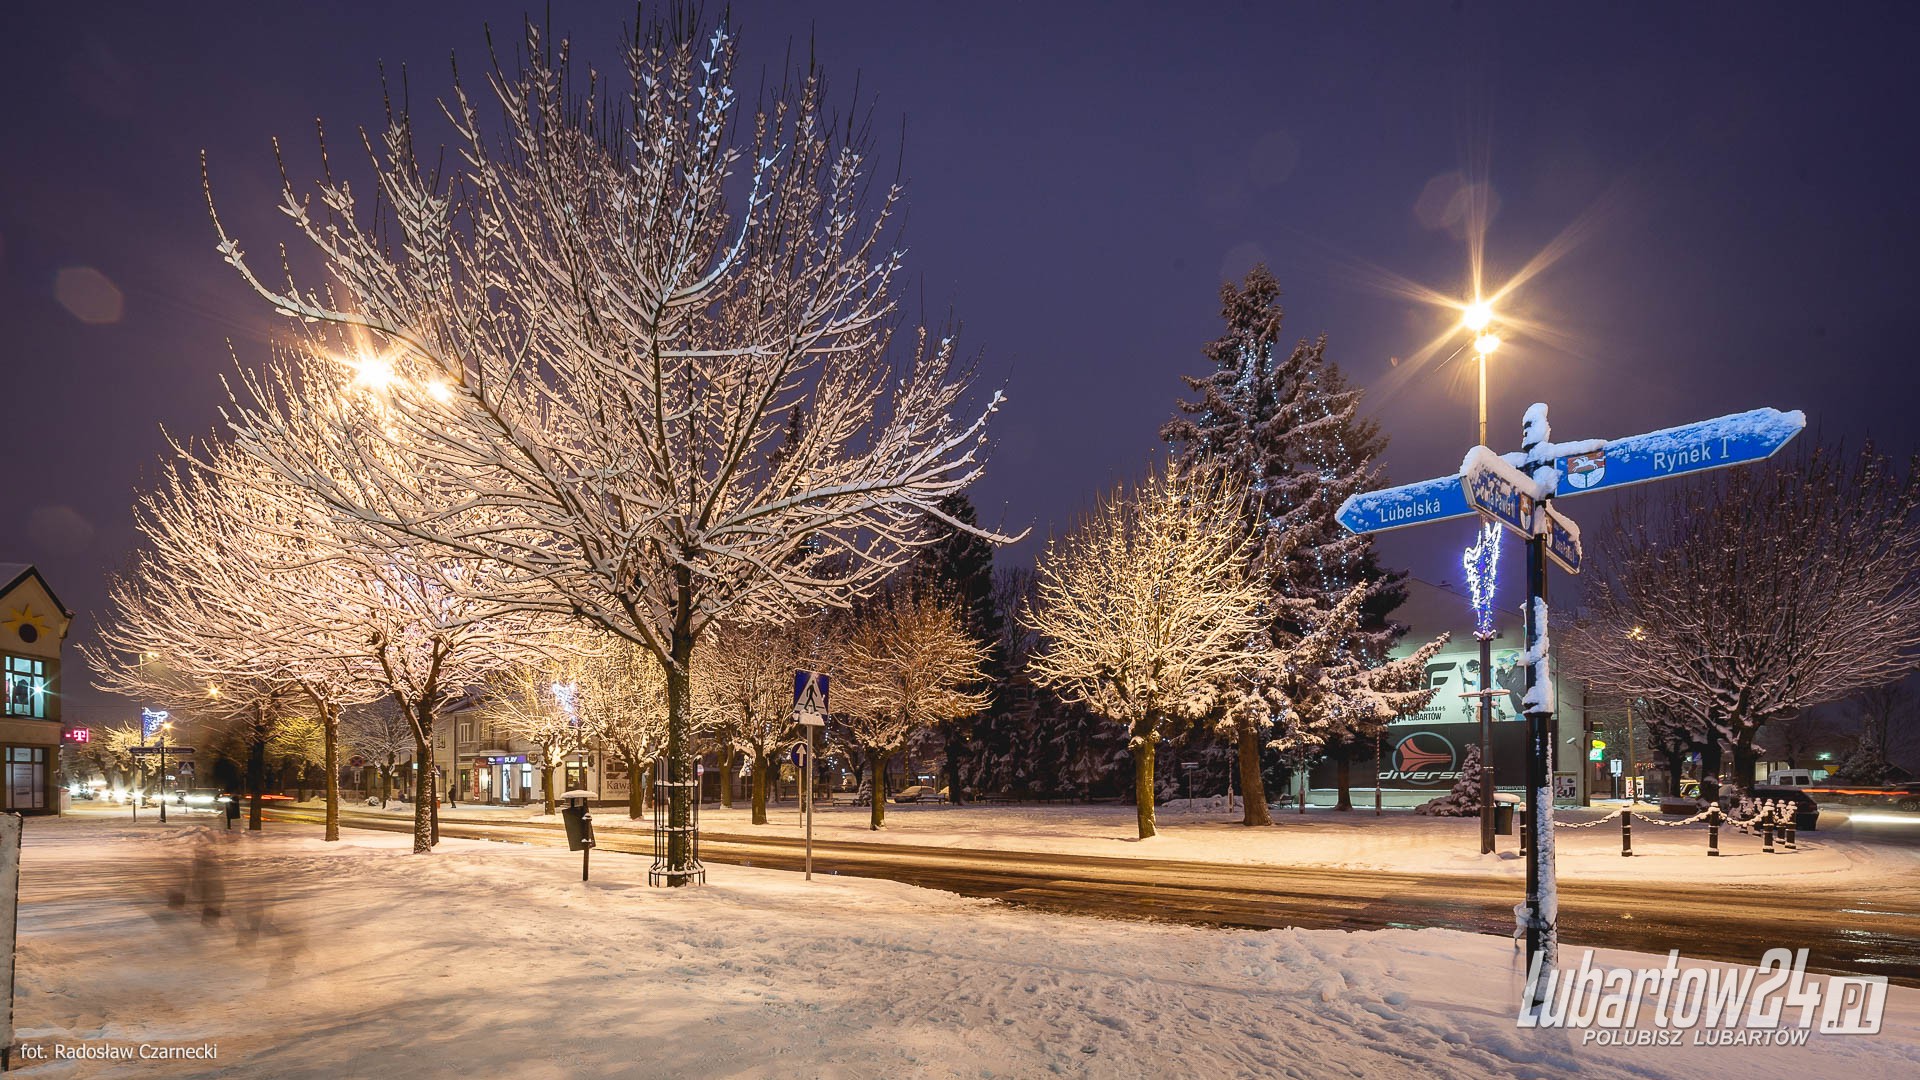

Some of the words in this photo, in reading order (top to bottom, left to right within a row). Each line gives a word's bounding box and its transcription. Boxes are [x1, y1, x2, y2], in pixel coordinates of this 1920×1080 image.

[1653, 442, 1712, 473] Rynek
[1380, 499, 1441, 523] Lubelska
[1408, 711, 1442, 721] LUBARTÓW
[1378, 769, 1464, 780] diverse
